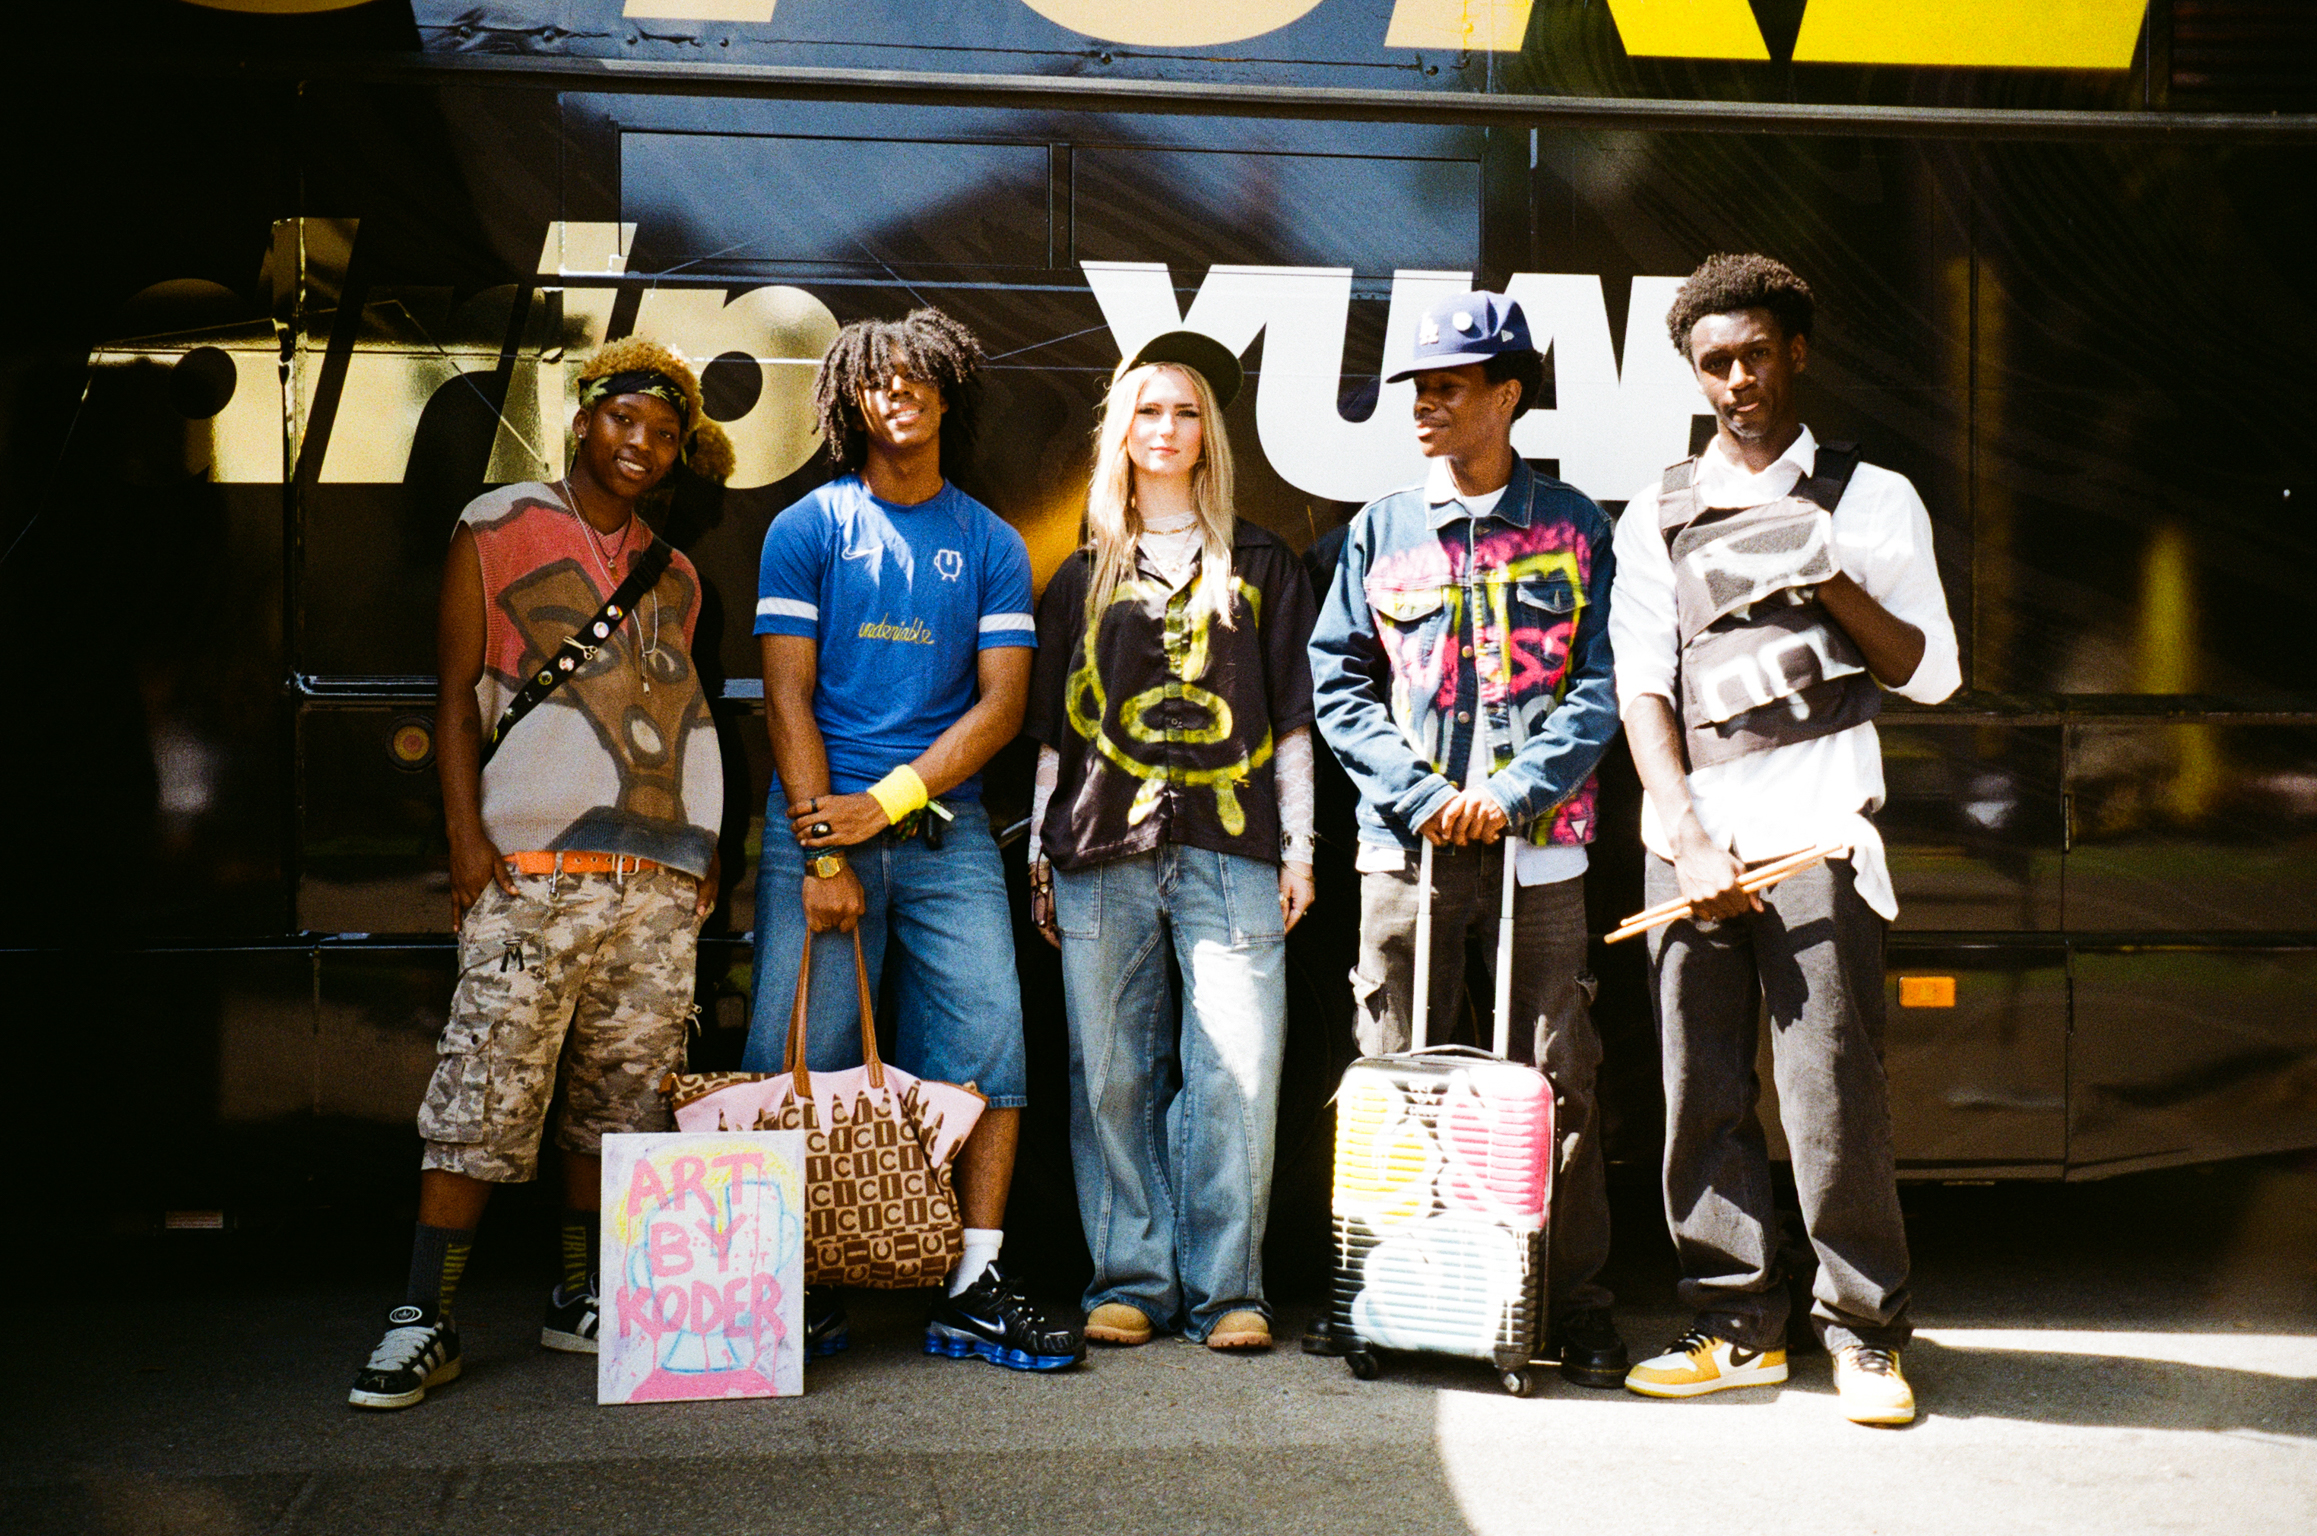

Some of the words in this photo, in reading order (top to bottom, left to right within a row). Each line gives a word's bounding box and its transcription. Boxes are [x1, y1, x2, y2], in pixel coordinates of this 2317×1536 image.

[627, 1152, 765, 1218] ART
[649, 1213, 747, 1277] BY
[615, 1271, 788, 1339] KODER
